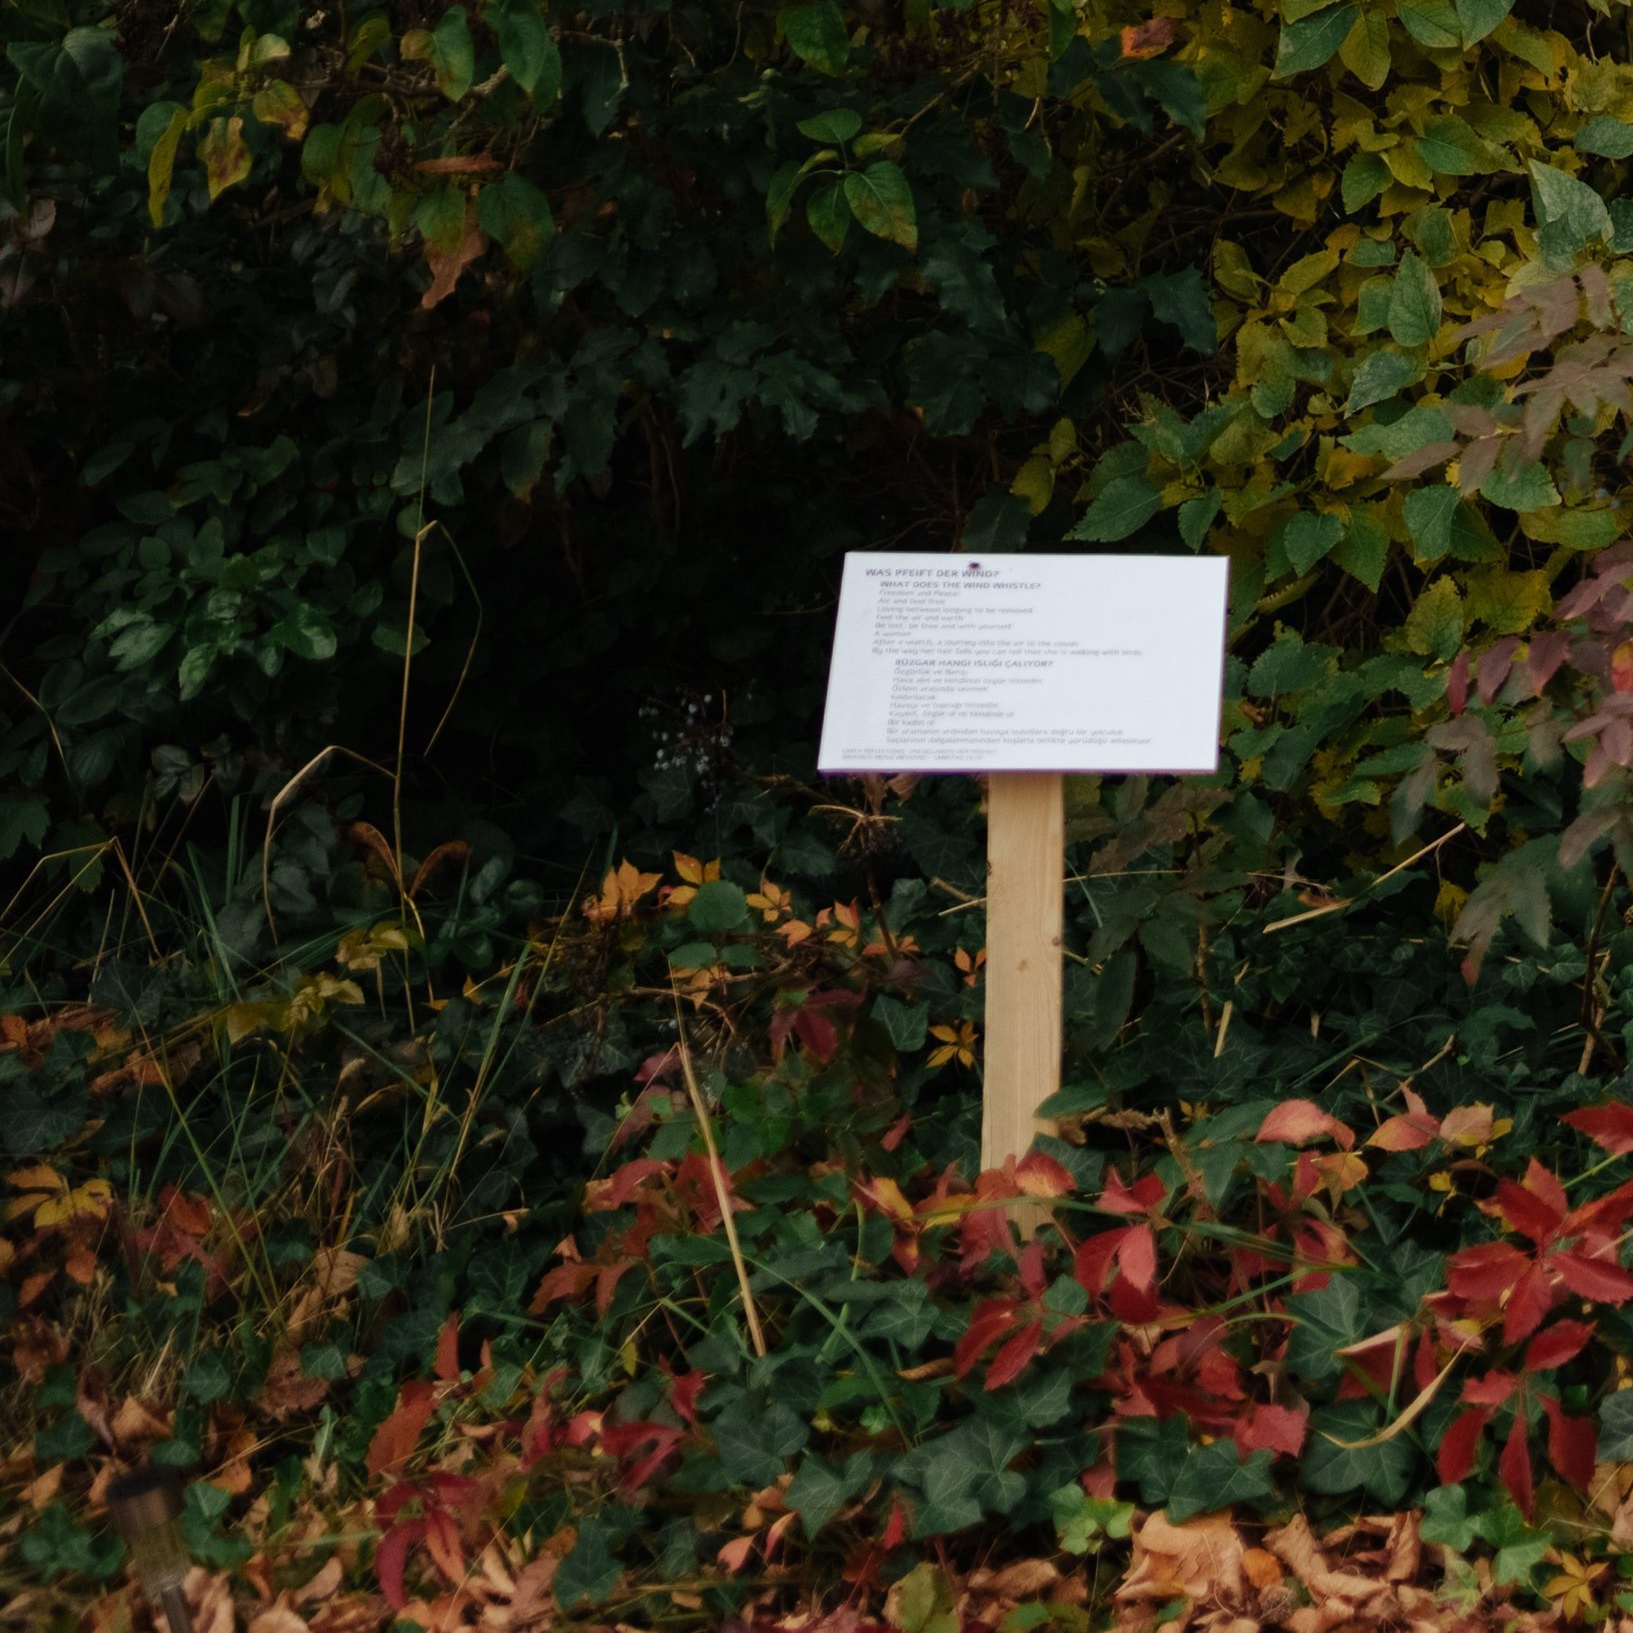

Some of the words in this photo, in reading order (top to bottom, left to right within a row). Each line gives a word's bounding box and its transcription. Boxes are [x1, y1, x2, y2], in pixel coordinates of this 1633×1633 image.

[865, 568, 892, 577] WAS
[894, 568, 933, 578] PFEIFT
[936, 569, 959, 578] DER
